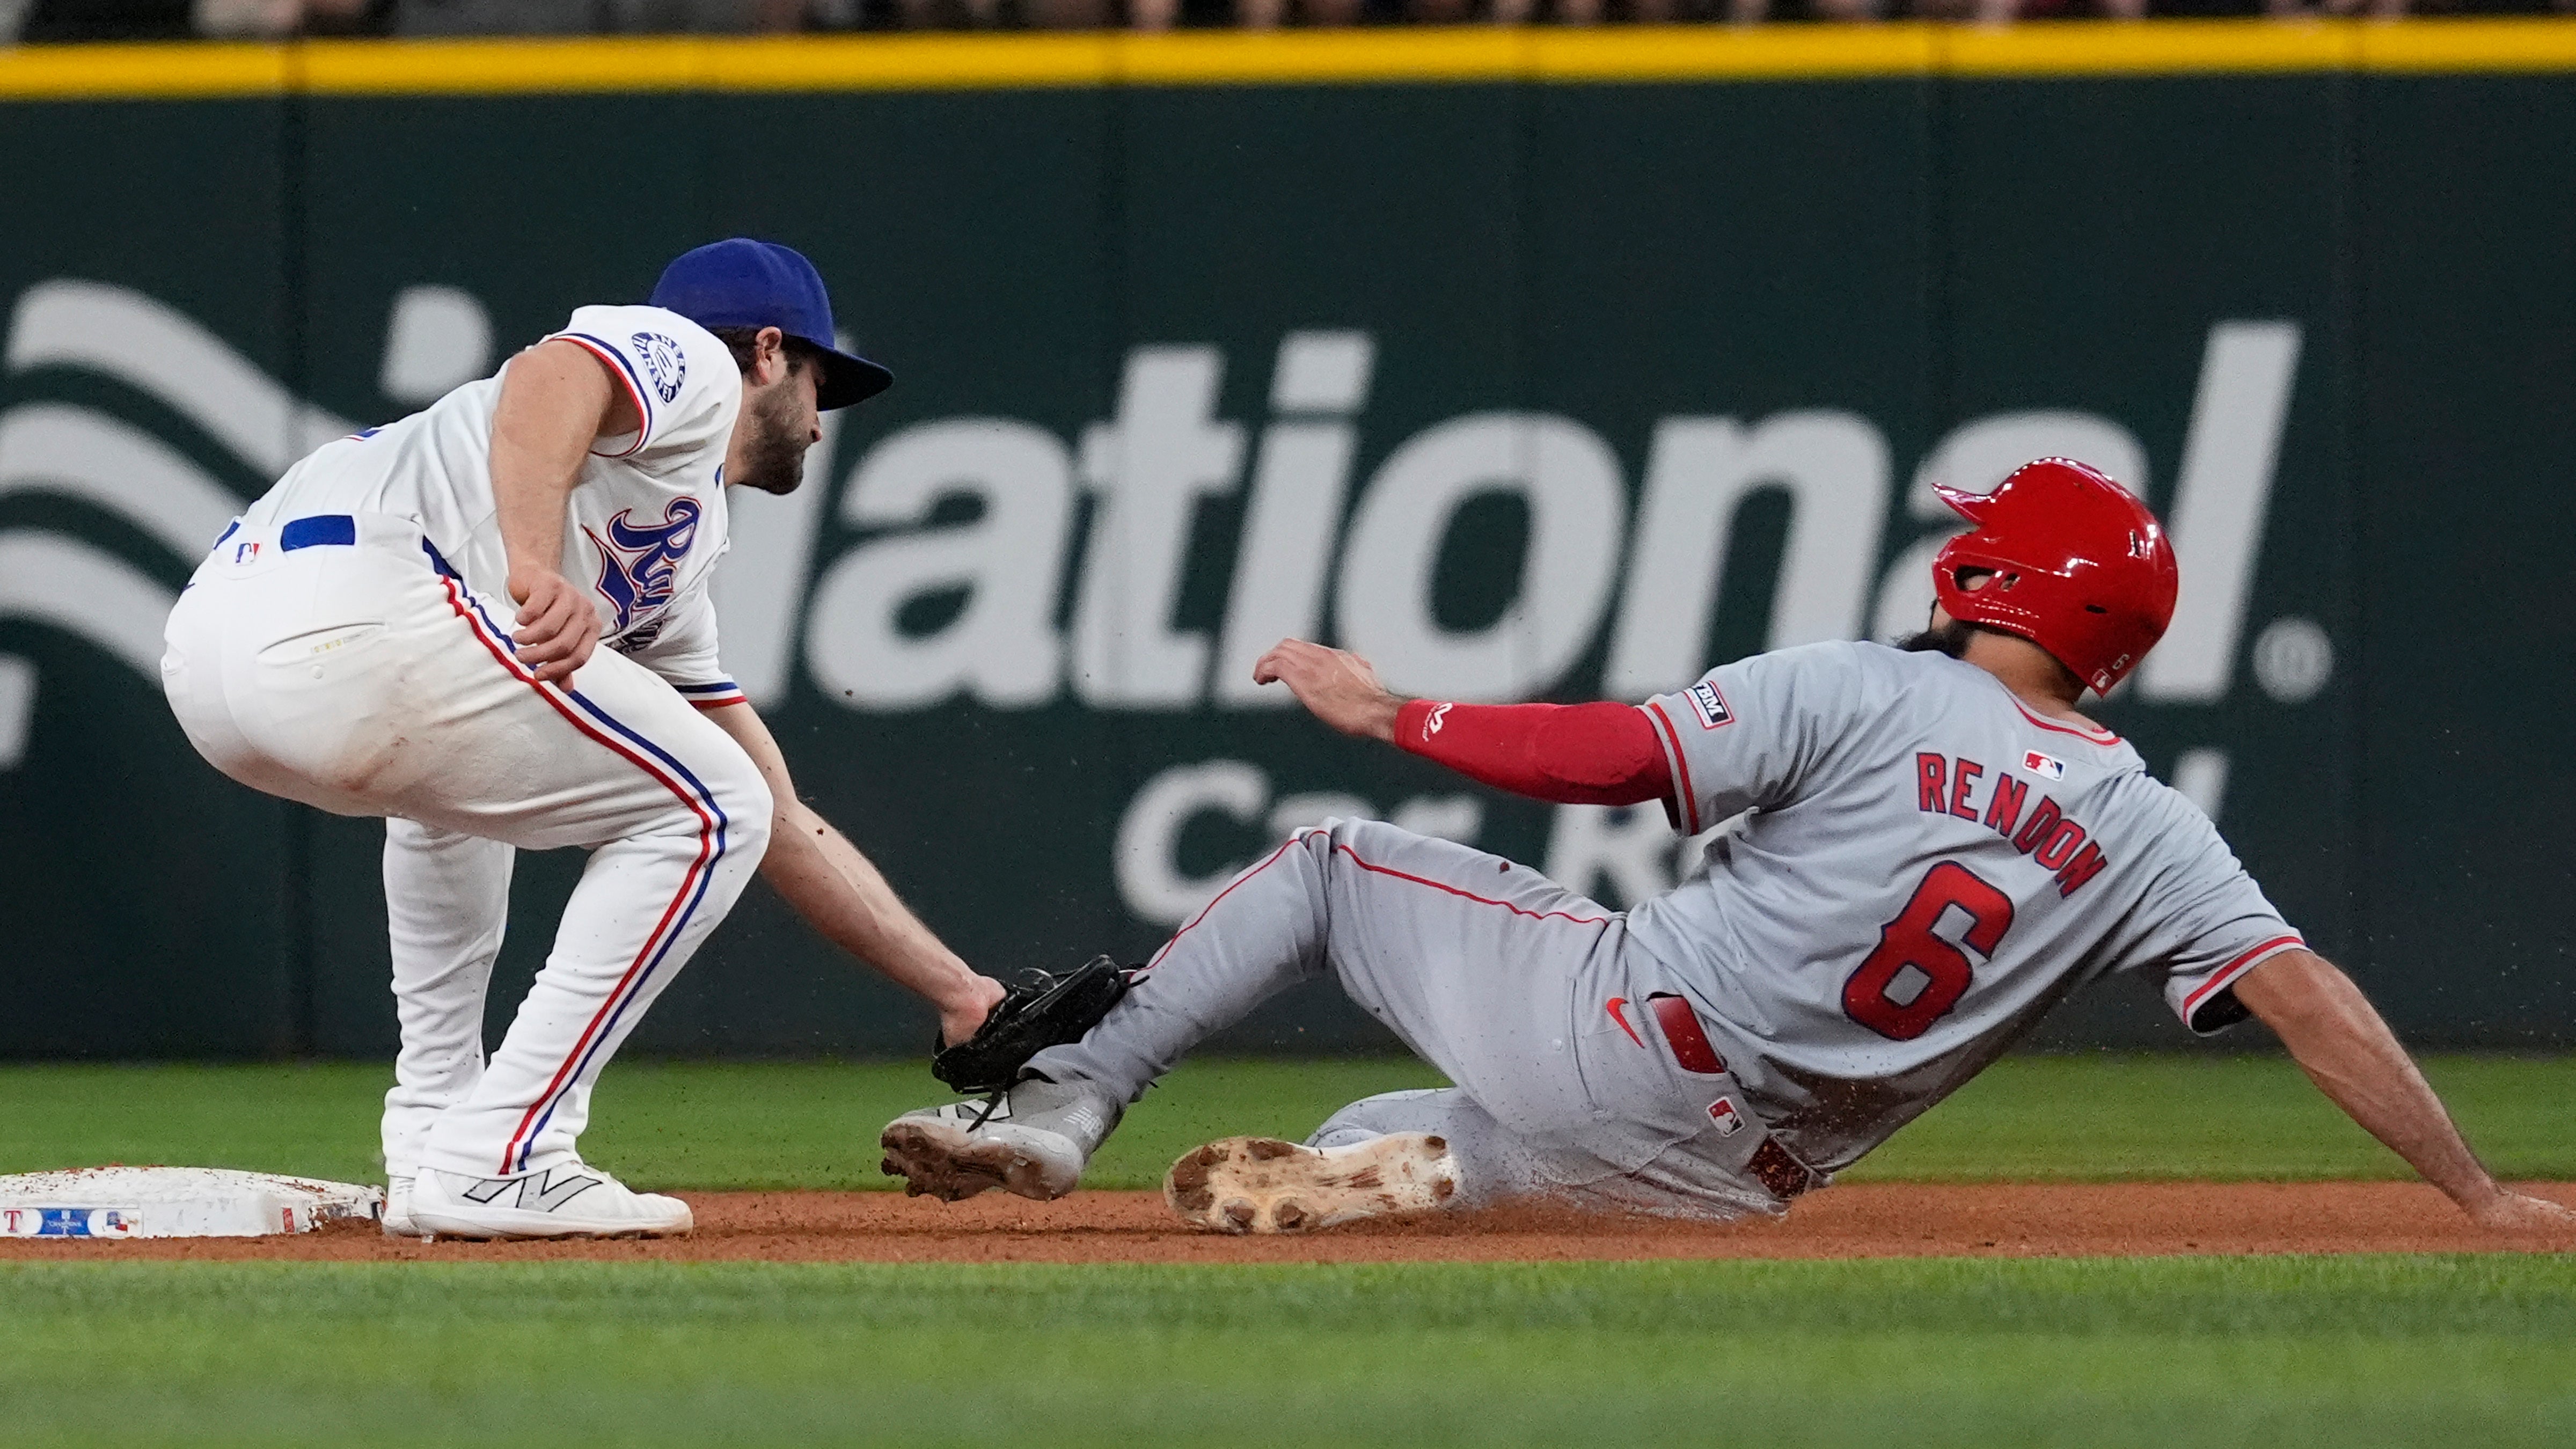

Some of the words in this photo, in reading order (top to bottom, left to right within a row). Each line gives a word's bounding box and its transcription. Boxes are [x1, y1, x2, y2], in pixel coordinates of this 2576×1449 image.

[708, 321, 2302, 713] ational
[2112, 654, 2130, 670] 6
[1916, 752, 2107, 899] RENDON
[1842, 860, 2014, 1041] 6
[4, 1210, 23, 1233] T
